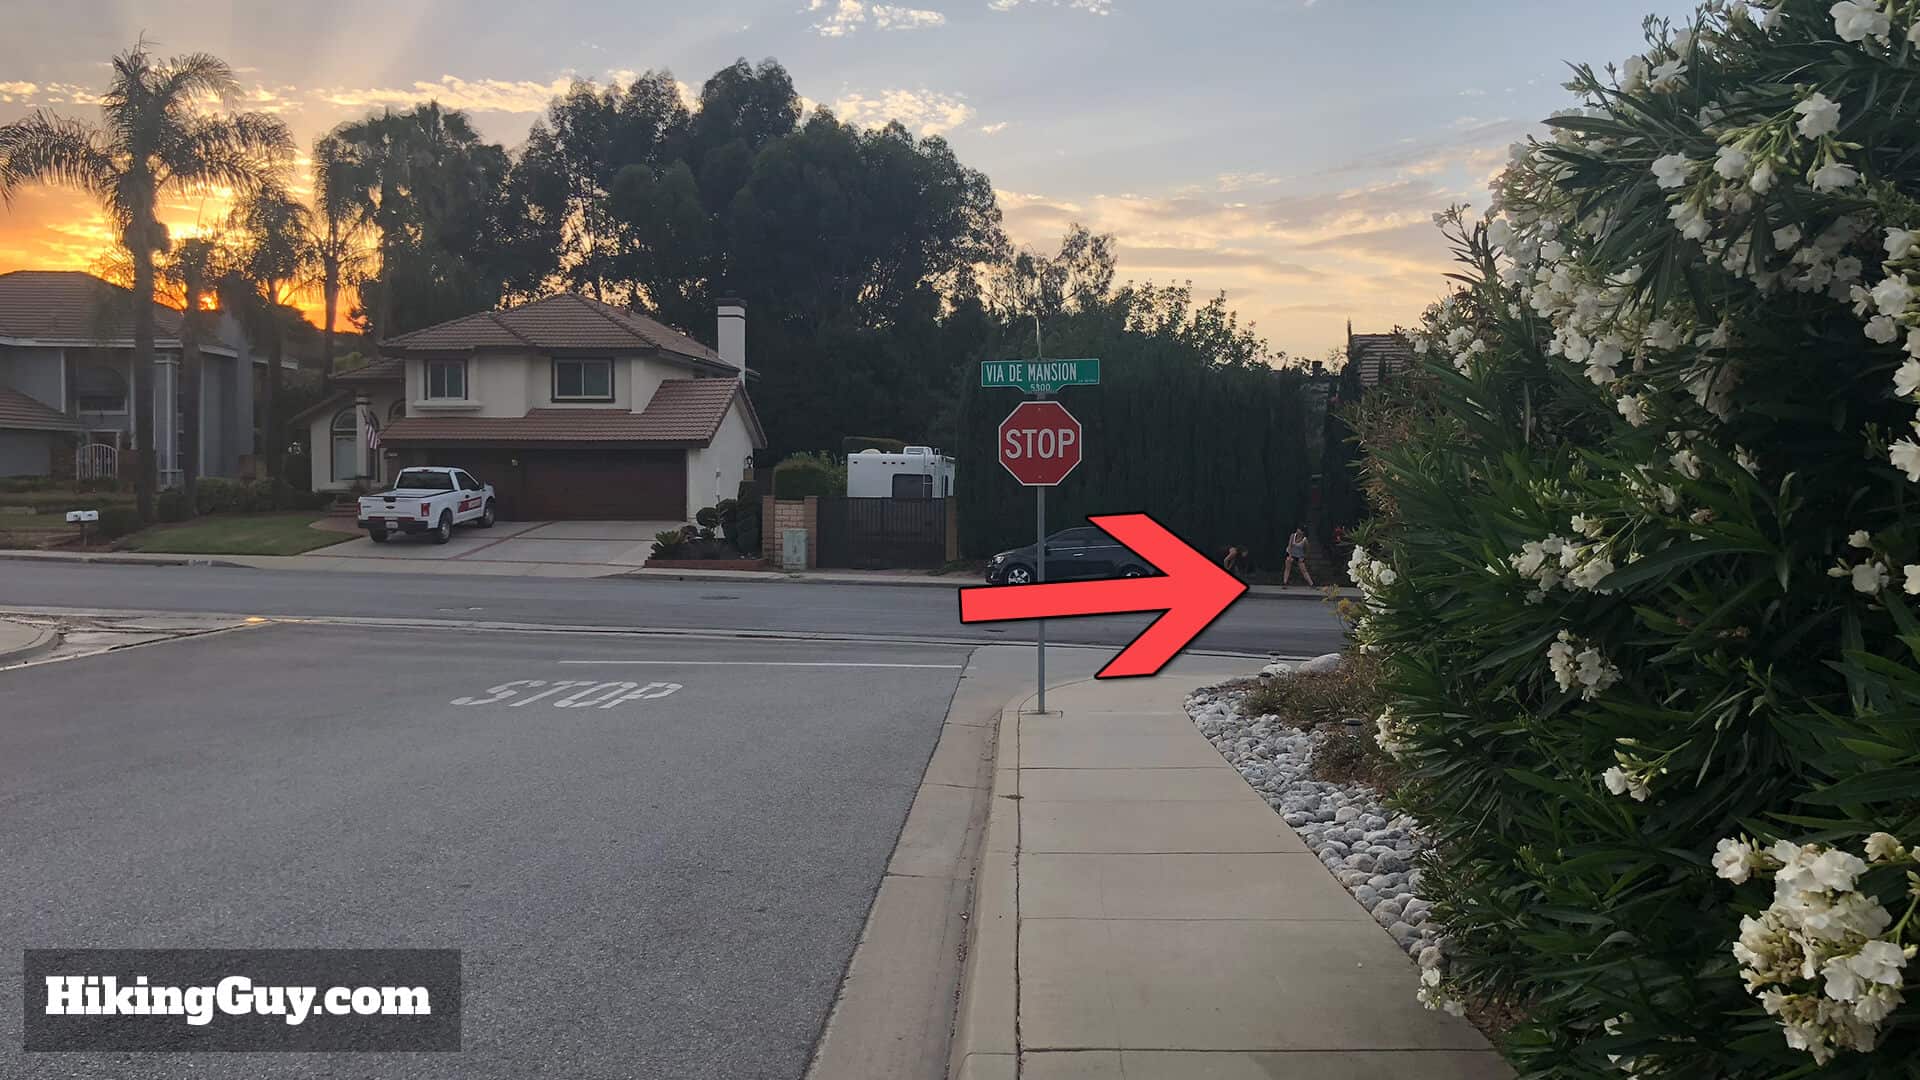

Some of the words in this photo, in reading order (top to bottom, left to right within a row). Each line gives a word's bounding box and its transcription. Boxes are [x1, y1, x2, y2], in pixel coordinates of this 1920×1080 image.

[986, 364, 1004, 382] VIA
[1009, 364, 1022, 382] DE
[1028, 363, 1077, 381] MANSION
[1005, 428, 1075, 459] STOP
[450, 680, 683, 709] STOP
